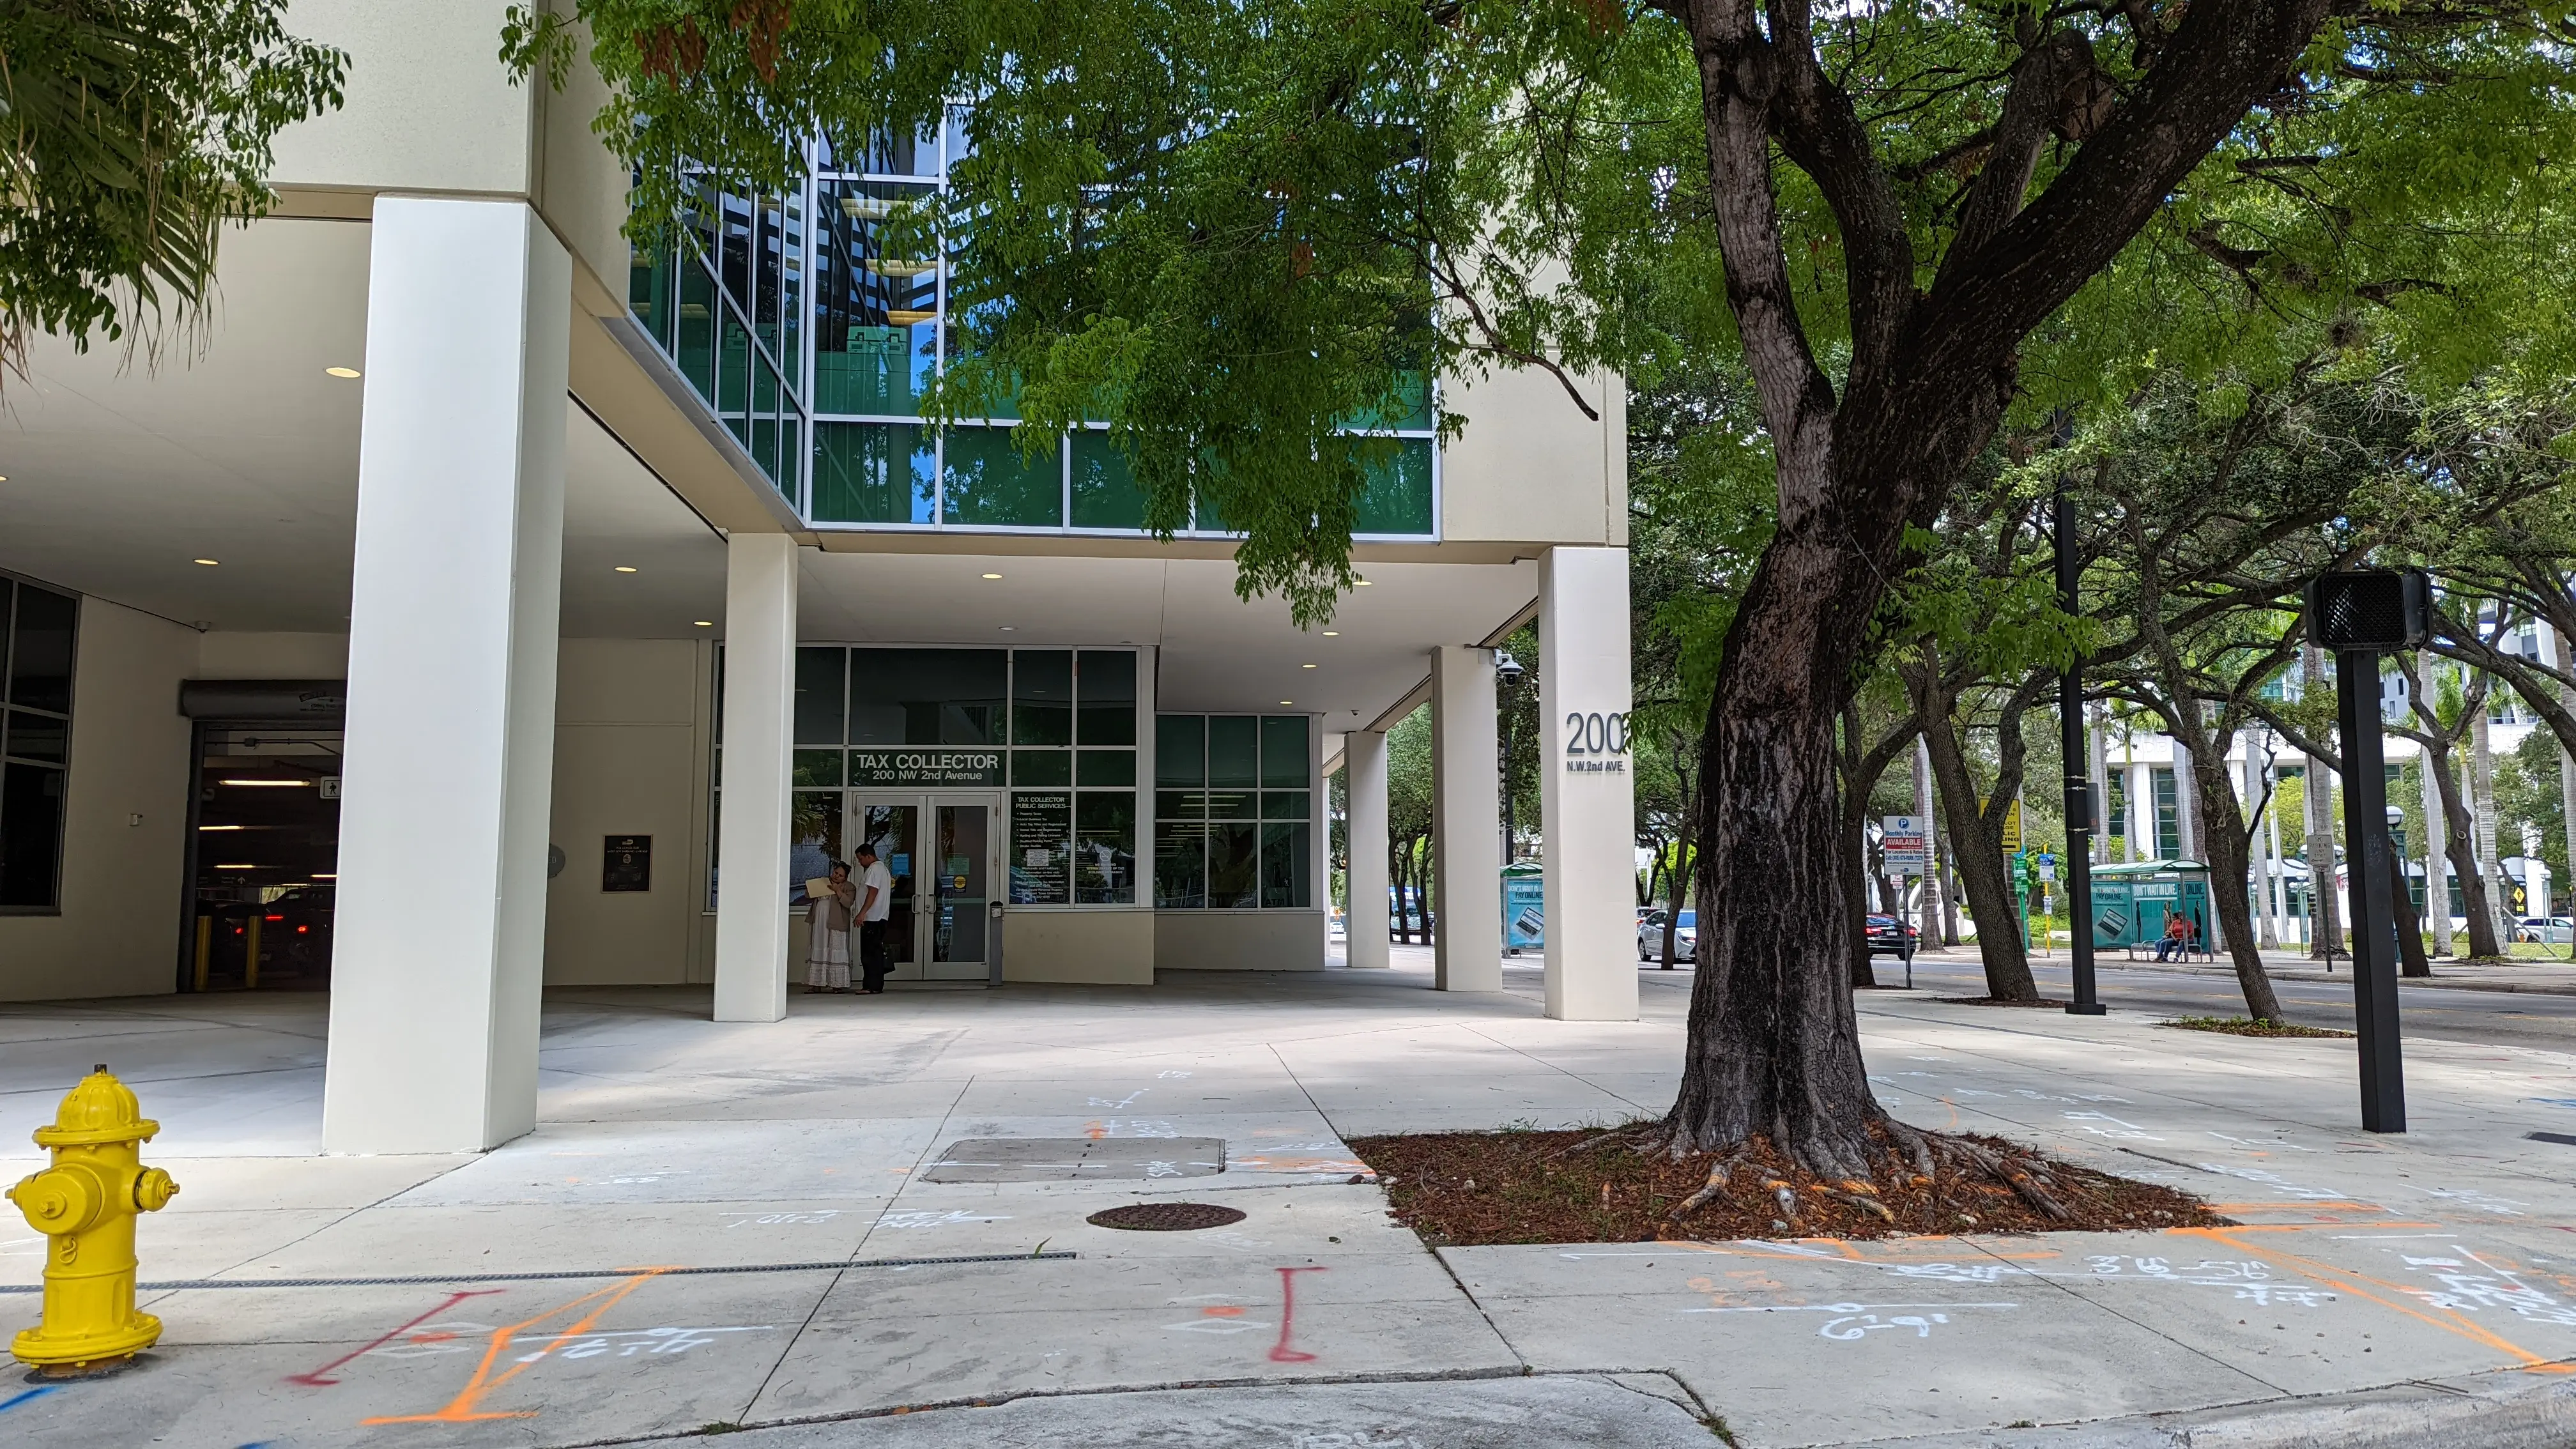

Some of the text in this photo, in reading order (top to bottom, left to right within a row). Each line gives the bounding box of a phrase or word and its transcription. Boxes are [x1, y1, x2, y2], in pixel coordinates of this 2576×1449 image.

[1567, 712, 1625, 753] 200
[856, 754, 999, 769] TAX COLLECTOR
[1605, 761, 1626, 772] AVE.
[873, 770, 983, 780] 200 NW 2nd Avenue
[2133, 884, 2147, 896] DON'T
[2147, 884, 2158, 896] WAIT
[2159, 884, 2164, 895] IN
